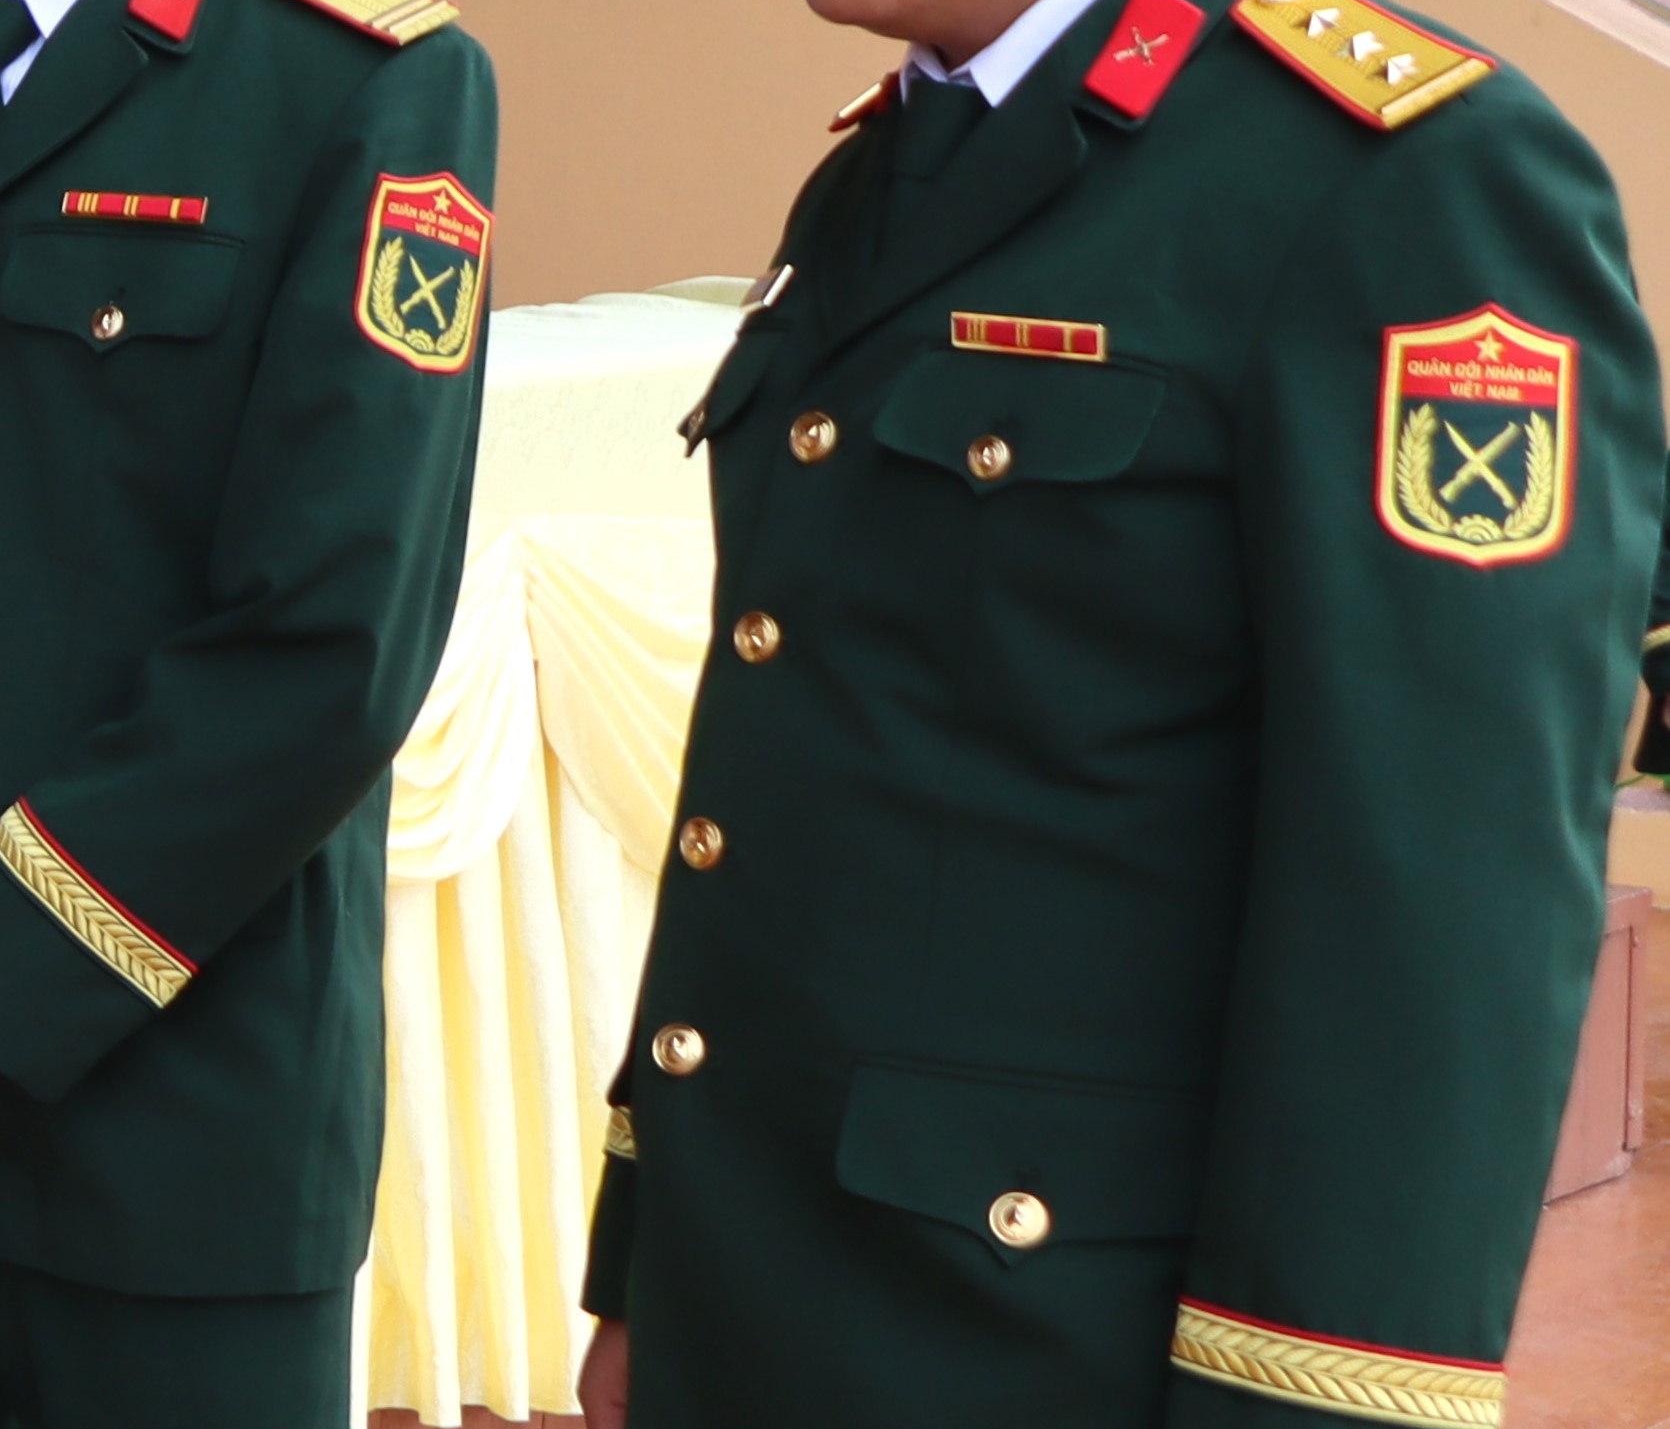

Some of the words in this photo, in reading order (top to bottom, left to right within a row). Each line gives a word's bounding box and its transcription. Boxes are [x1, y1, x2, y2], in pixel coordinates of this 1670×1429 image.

[1407, 357, 1452, 377] QUÂN
[1449, 380, 1482, 399] VIỆT
[1485, 383, 1522, 401] NAM
